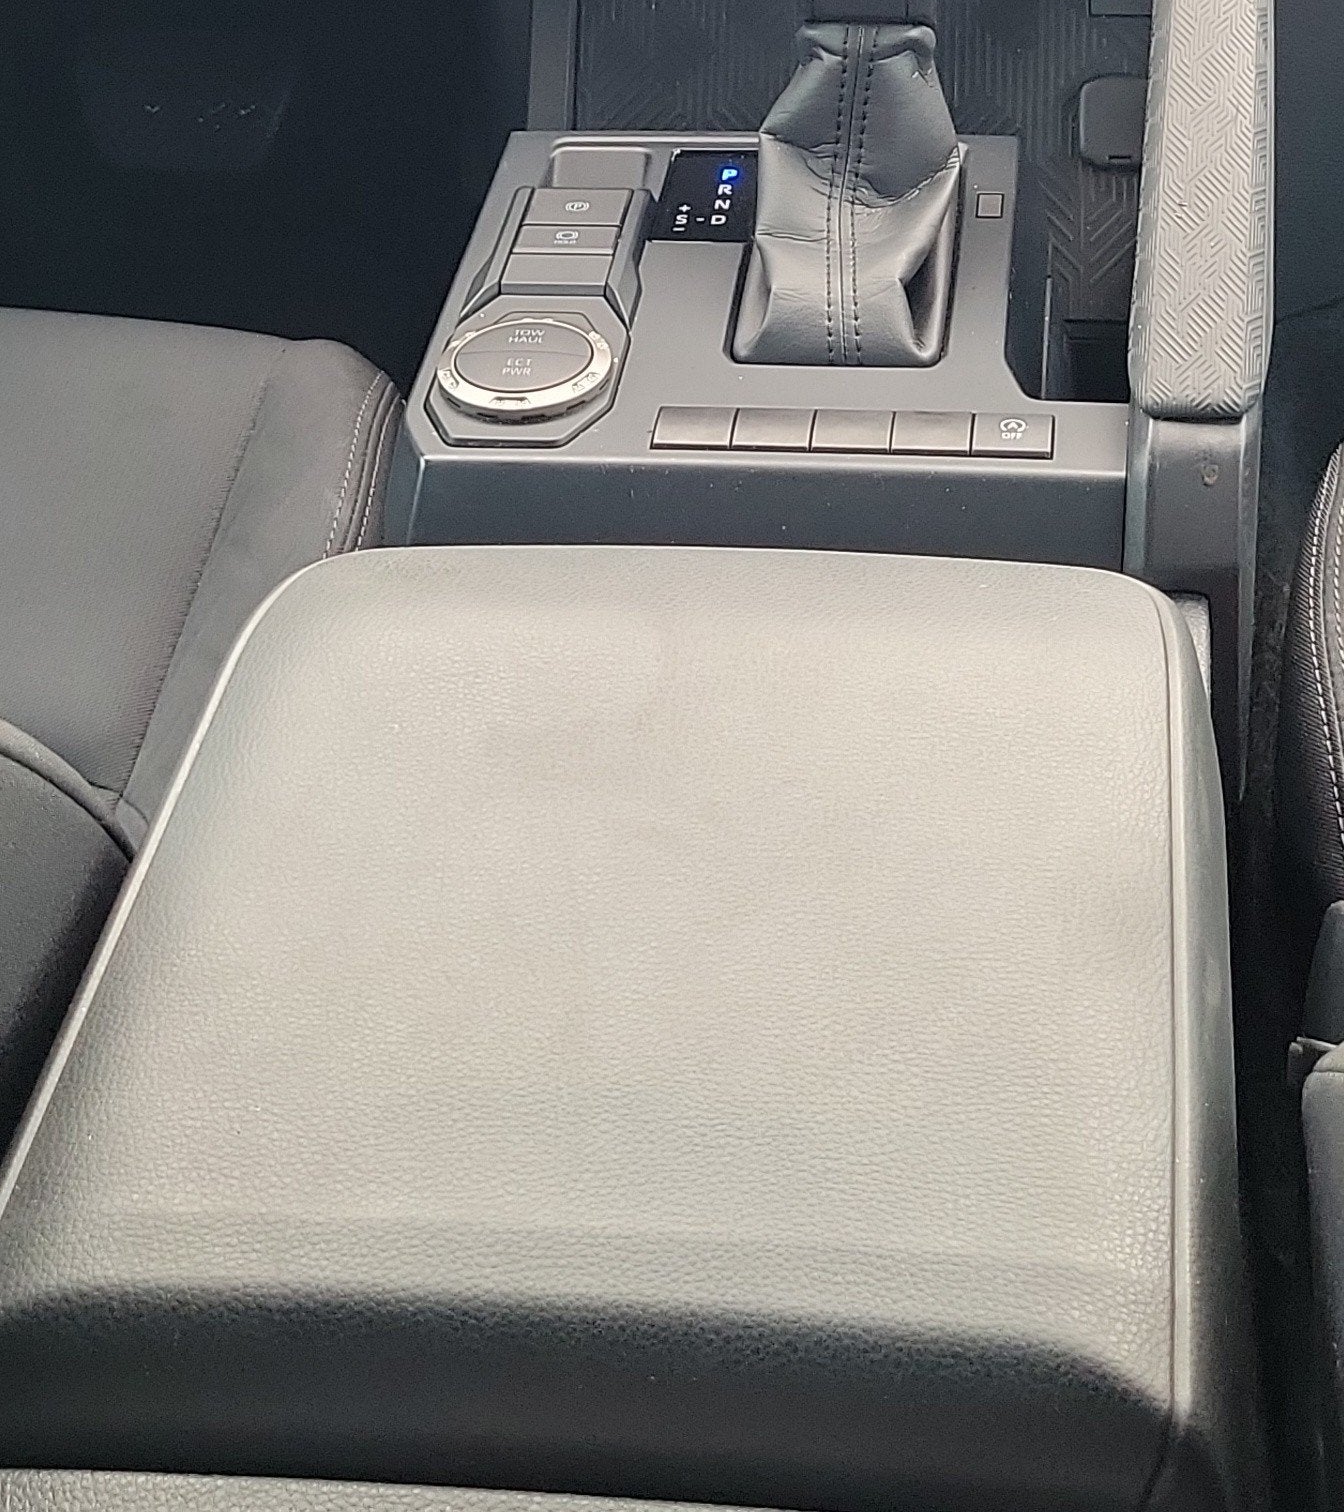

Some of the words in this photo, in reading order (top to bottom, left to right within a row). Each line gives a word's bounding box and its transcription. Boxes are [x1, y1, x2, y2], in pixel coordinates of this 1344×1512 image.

[722, 169, 738, 181] P
[718, 184, 733, 195] R
[714, 199, 731, 210] N
[675, 214, 689, 225] S
[710, 214, 727, 225] D
[506, 358, 533, 366] ECT
[502, 367, 531, 376] PWR
[1001, 432, 1023, 440] OFF
